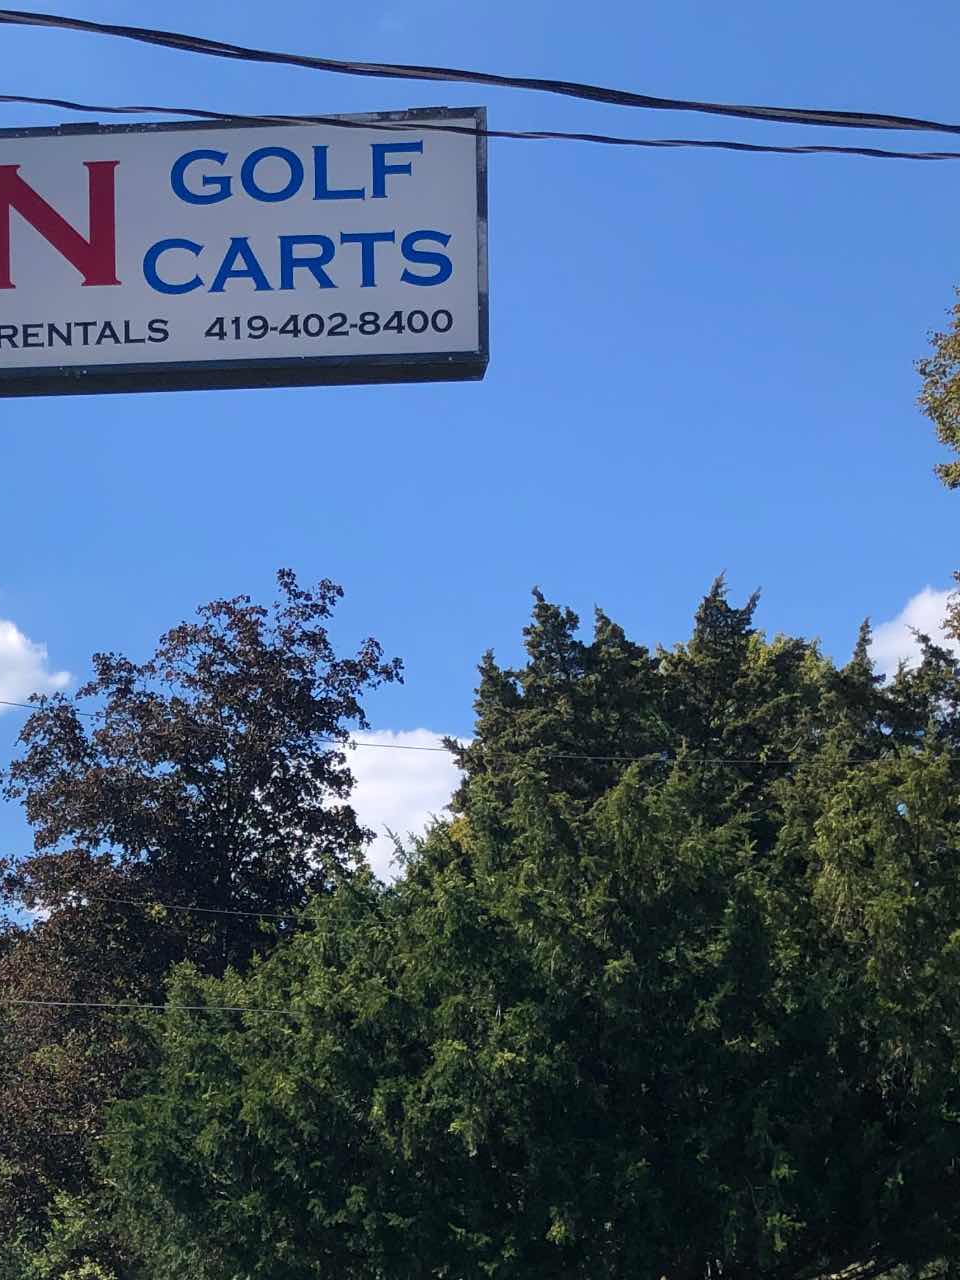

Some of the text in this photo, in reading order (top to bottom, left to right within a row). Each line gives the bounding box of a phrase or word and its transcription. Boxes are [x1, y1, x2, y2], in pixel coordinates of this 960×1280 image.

[171, 140, 423, 206] GOLF
[143, 230, 452, 294] CARTS
[205, 310, 453, 341] 419-402-8400
